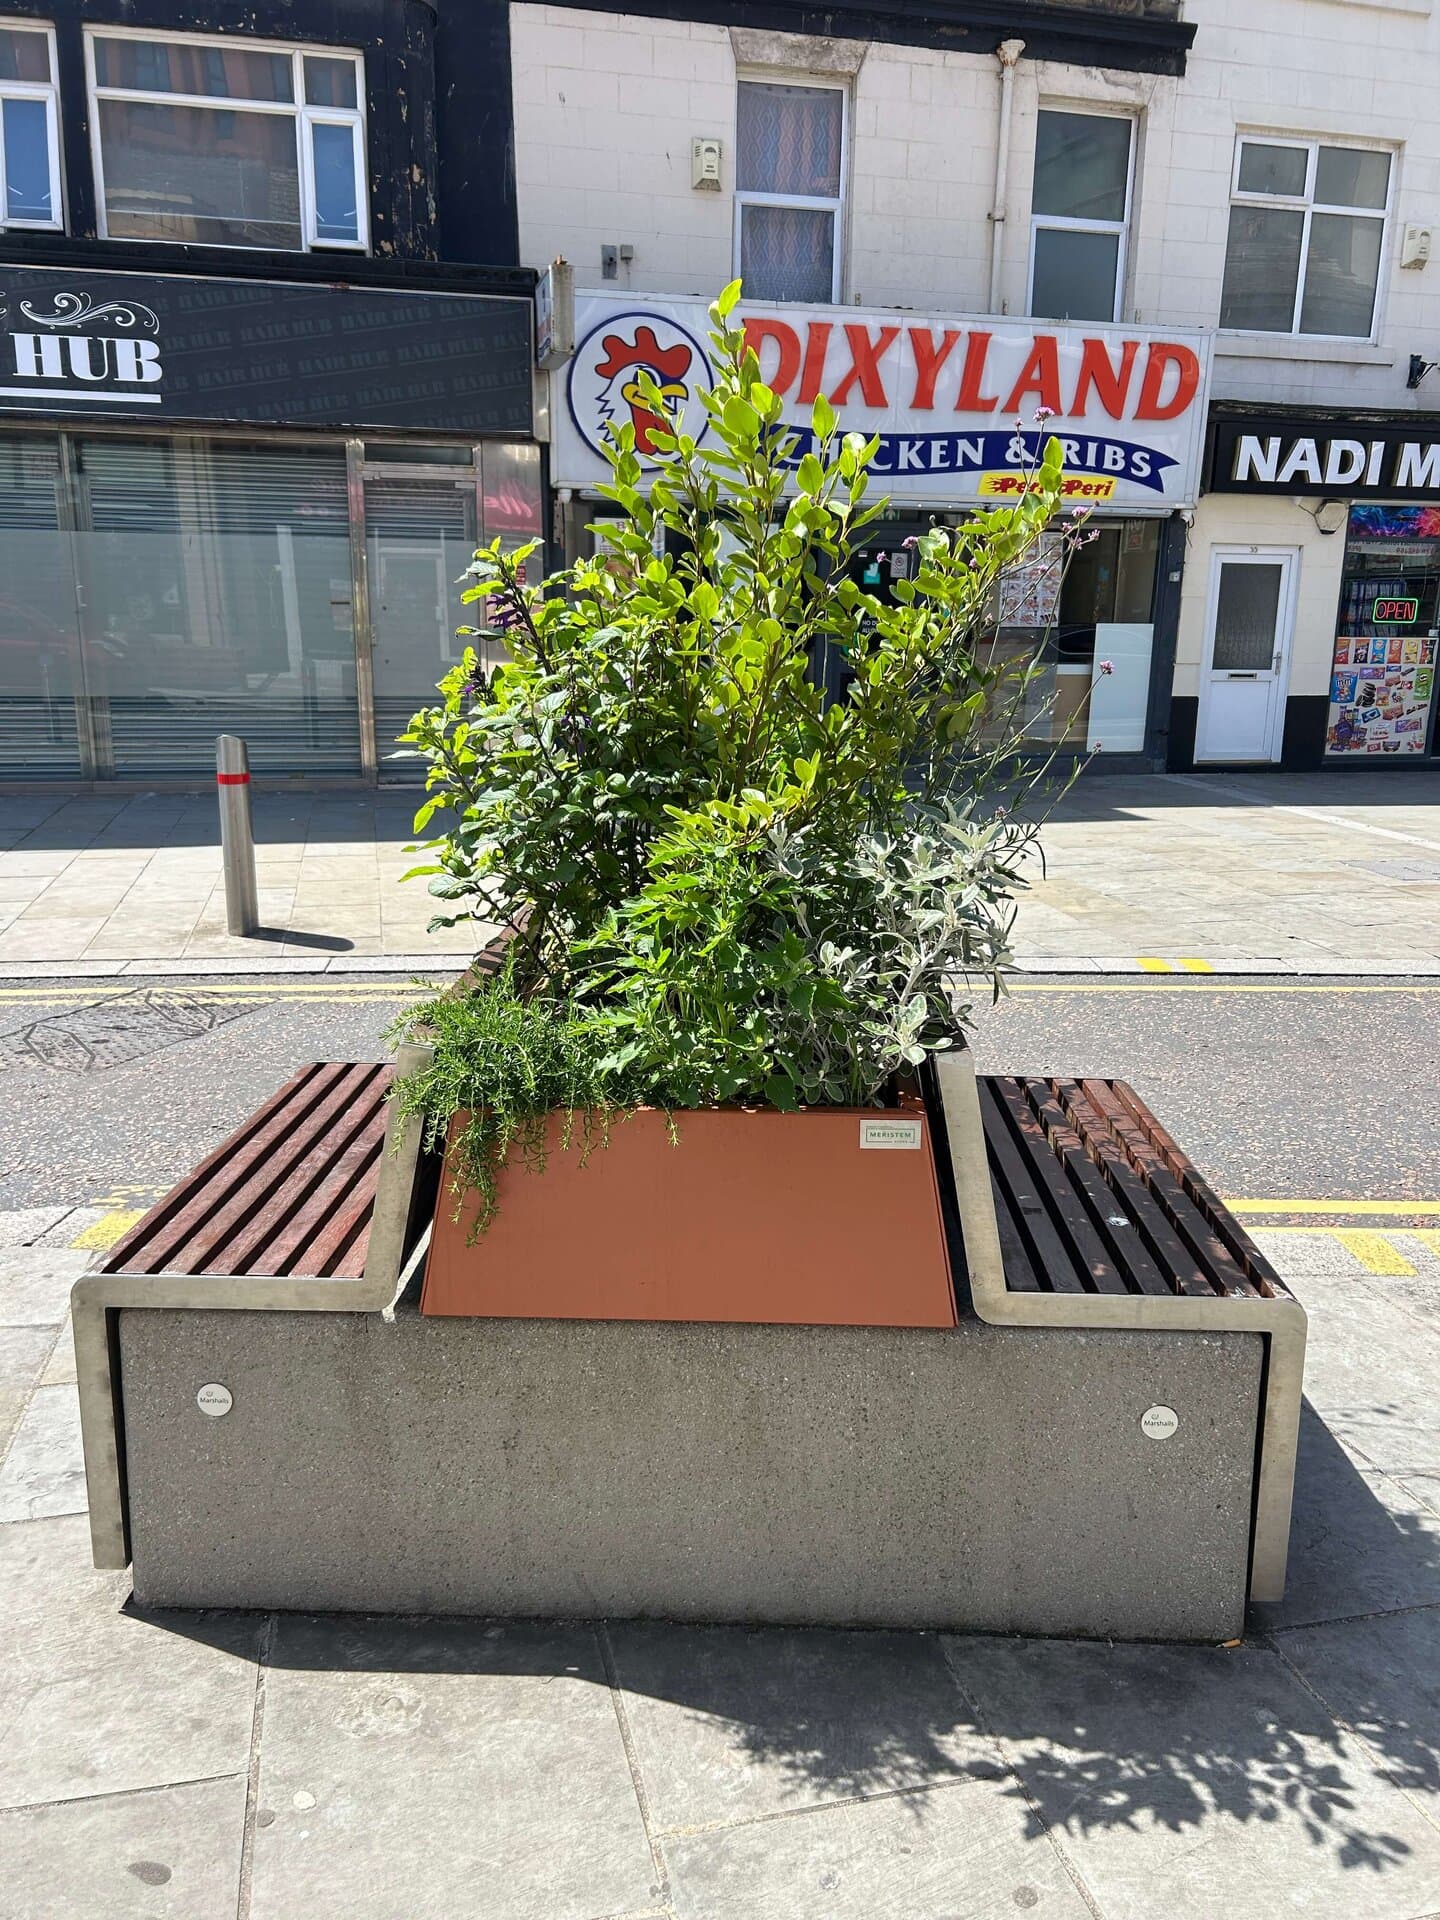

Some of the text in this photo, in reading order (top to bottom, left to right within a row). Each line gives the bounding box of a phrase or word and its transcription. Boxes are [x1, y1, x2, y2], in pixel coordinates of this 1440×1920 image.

[8, 332, 163, 382] HUB
[741, 317, 1200, 422] DIXYLAND
[1004, 435, 1040, 464] &
[1062, 438, 1153, 478] RIBS
[1234, 435, 1385, 485] NADI
[1062, 479, 1113, 497] Peri
[1376, 602, 1415, 620] OPEN
